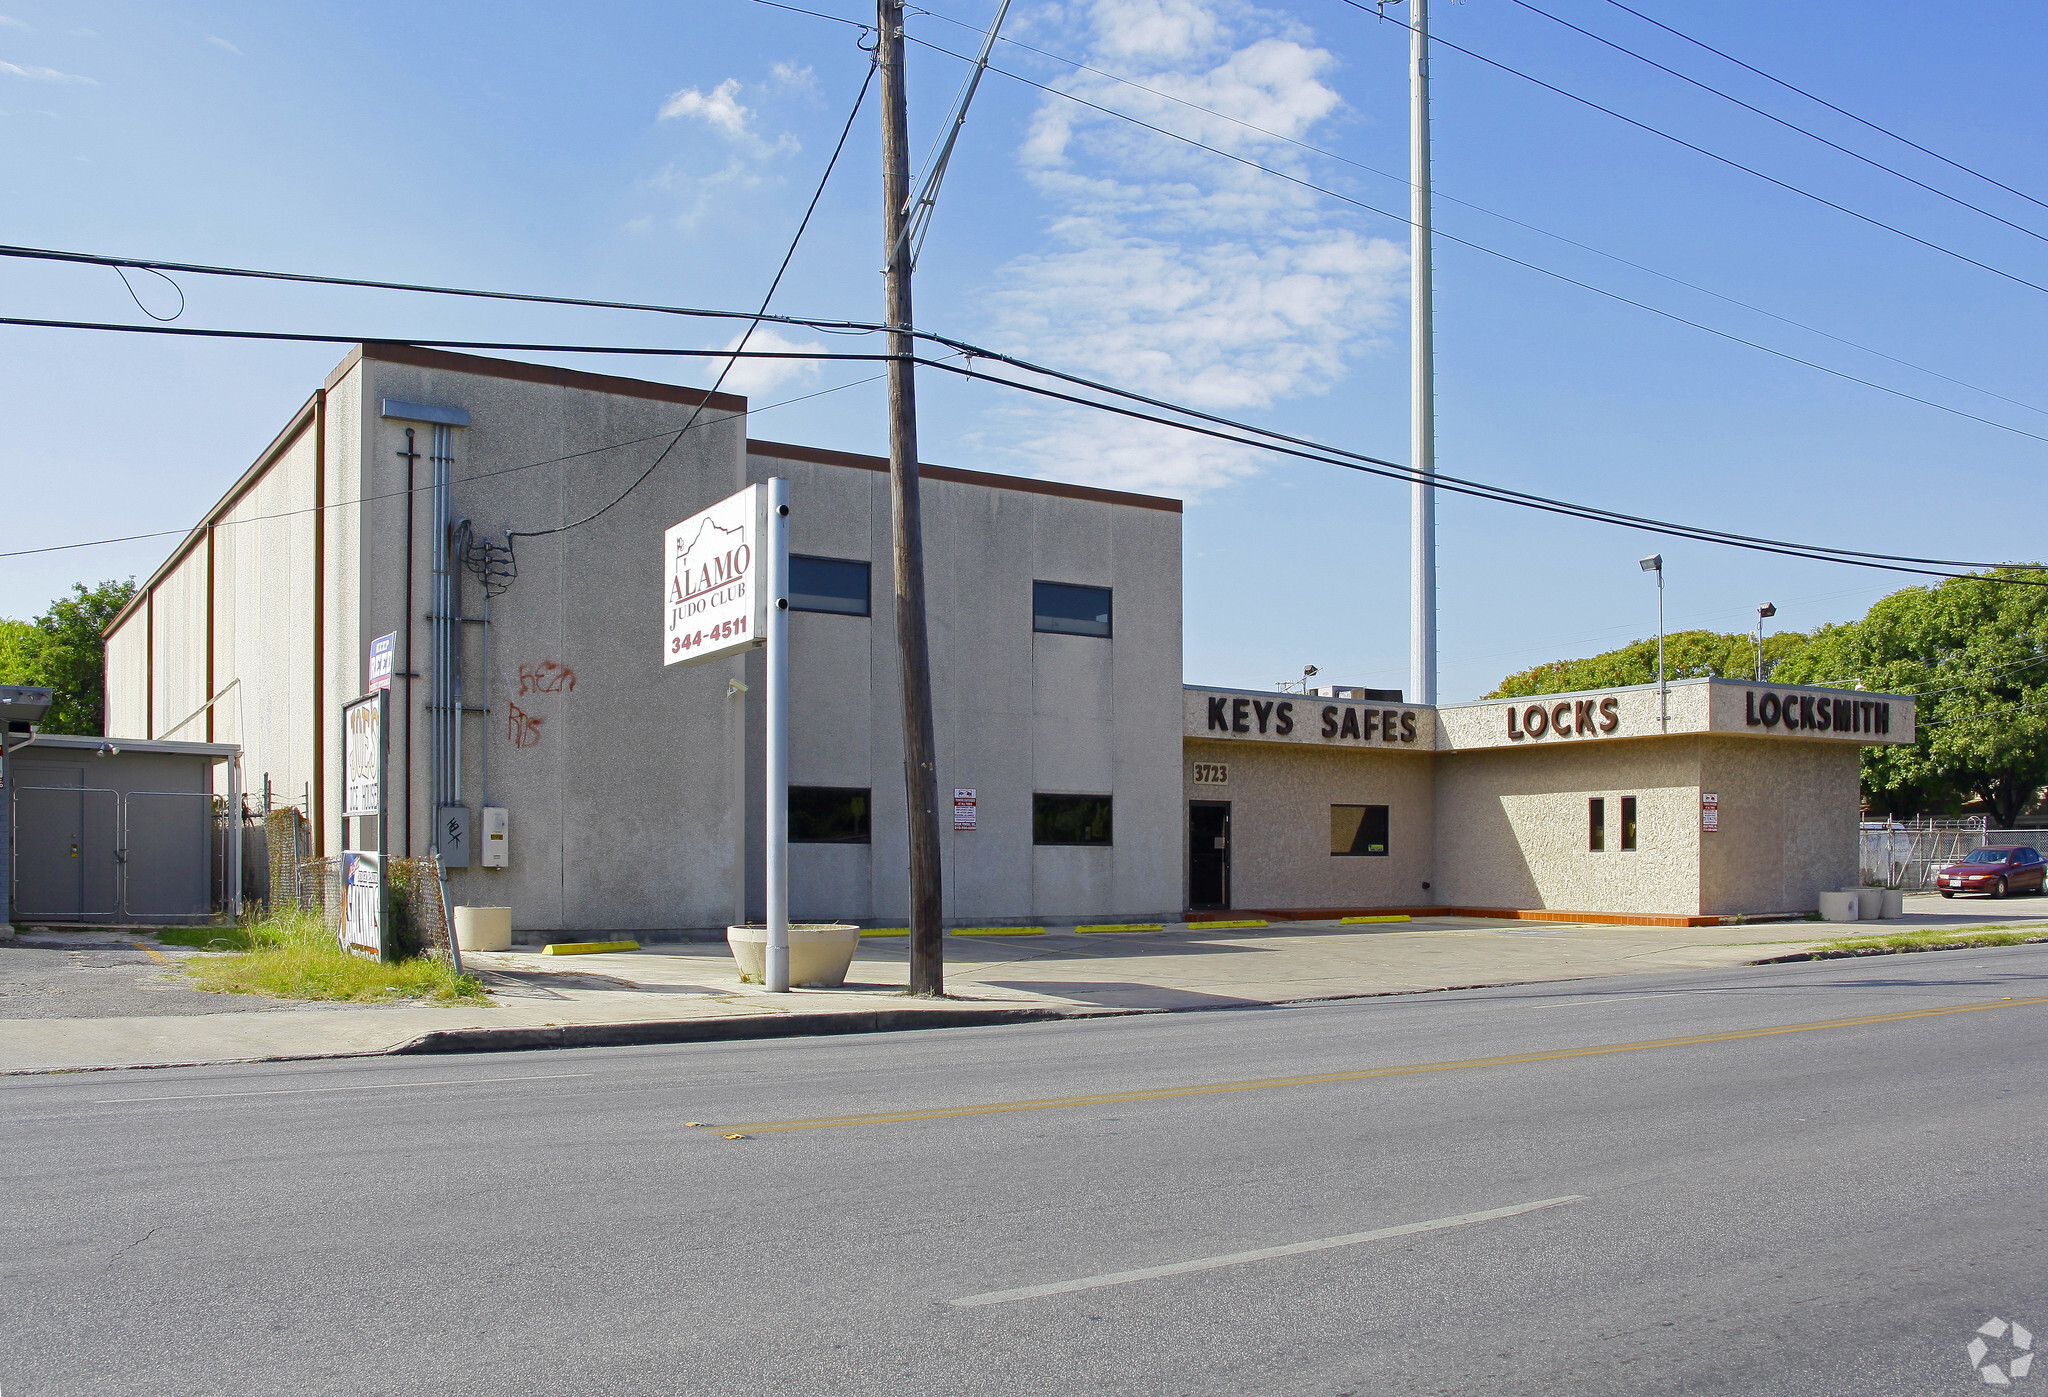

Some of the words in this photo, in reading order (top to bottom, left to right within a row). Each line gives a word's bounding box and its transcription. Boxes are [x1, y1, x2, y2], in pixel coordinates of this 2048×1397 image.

[669, 544, 751, 604] ALAMO
[669, 598, 706, 632] JUDO
[710, 581, 746, 608] CLUB
[671, 615, 747, 654] 344-4511
[1208, 696, 1294, 736] KEYS
[1321, 705, 1418, 743] SAFES
[1507, 697, 1619, 741] LOCKS
[1746, 690, 1891, 735] LOCKSMITH
[1194, 764, 1228, 783] 3723
